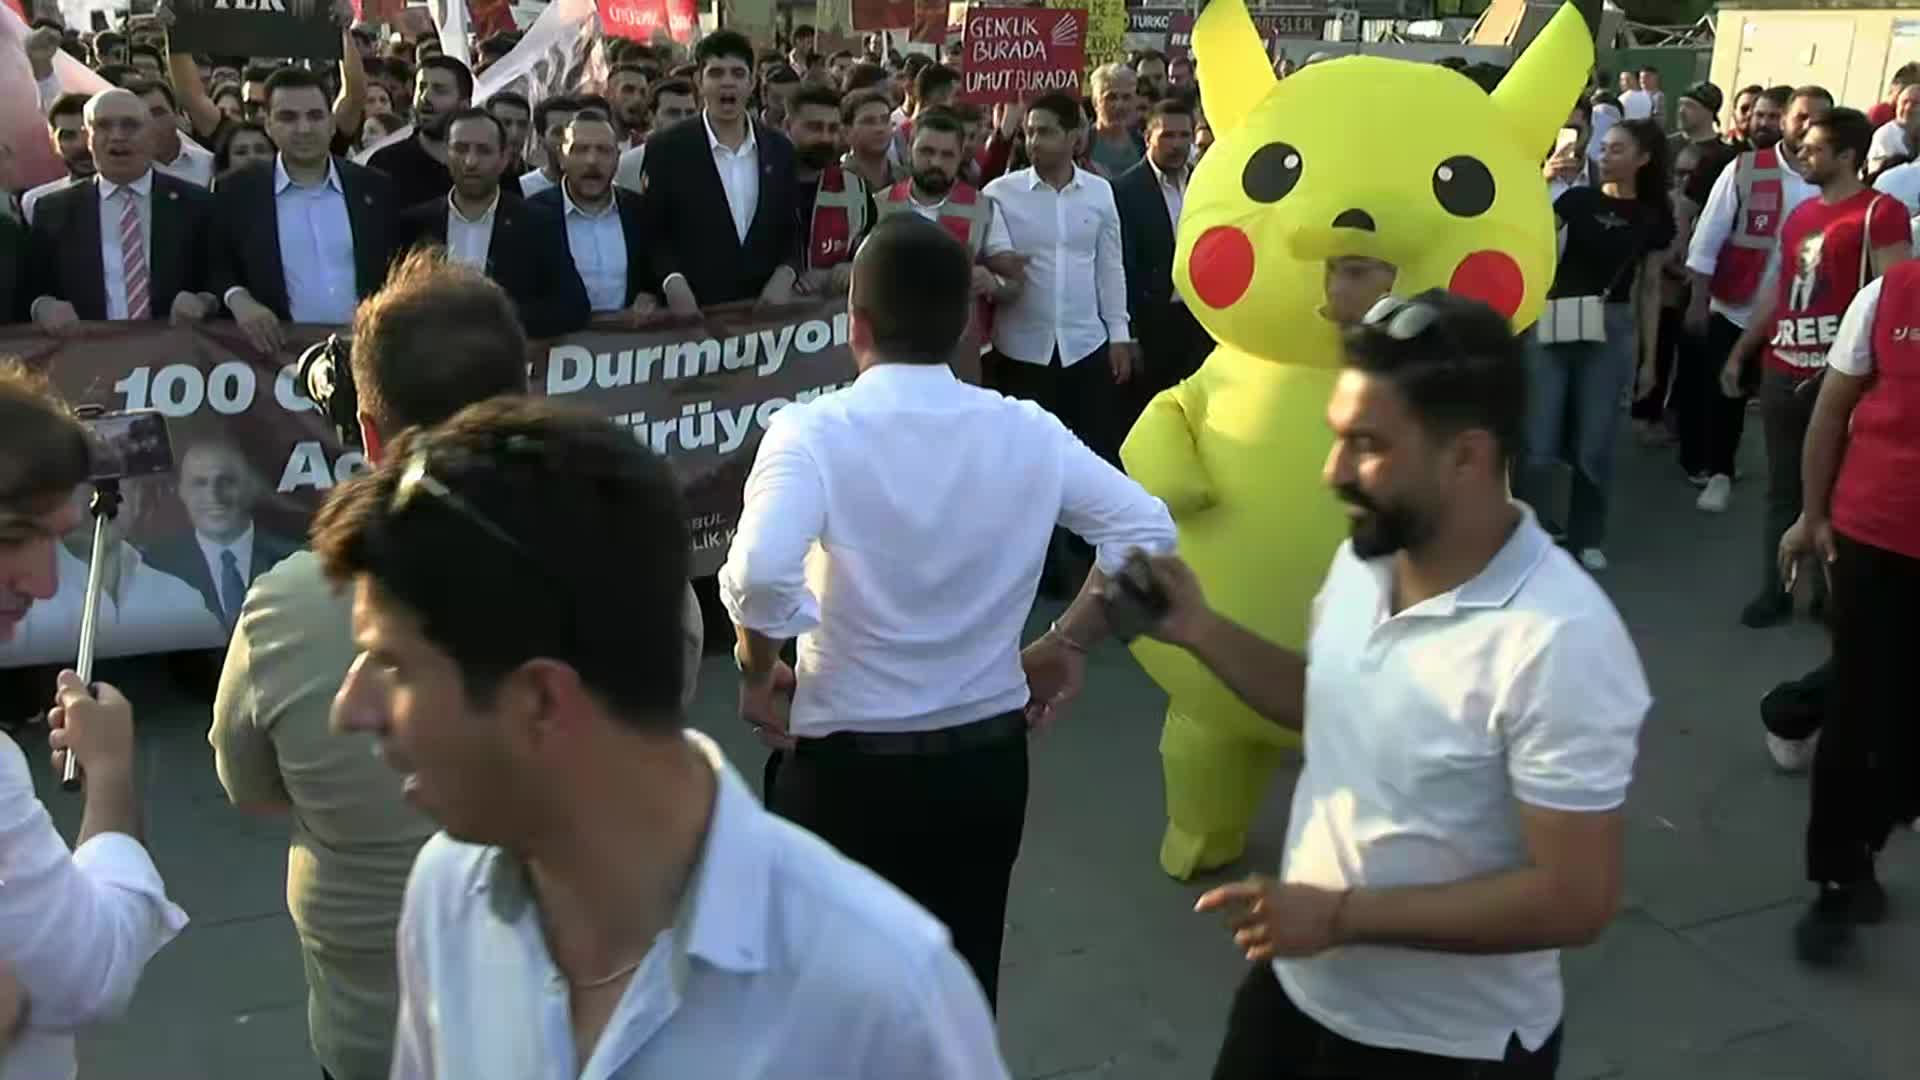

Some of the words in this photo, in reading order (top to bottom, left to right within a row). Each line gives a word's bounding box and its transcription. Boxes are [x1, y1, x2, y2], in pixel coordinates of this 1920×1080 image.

[973, 40, 1047, 62] BURADA
[966, 70, 1013, 93] UMUT
[1015, 70, 1079, 91] BURADA
[114, 361, 256, 416] 100
